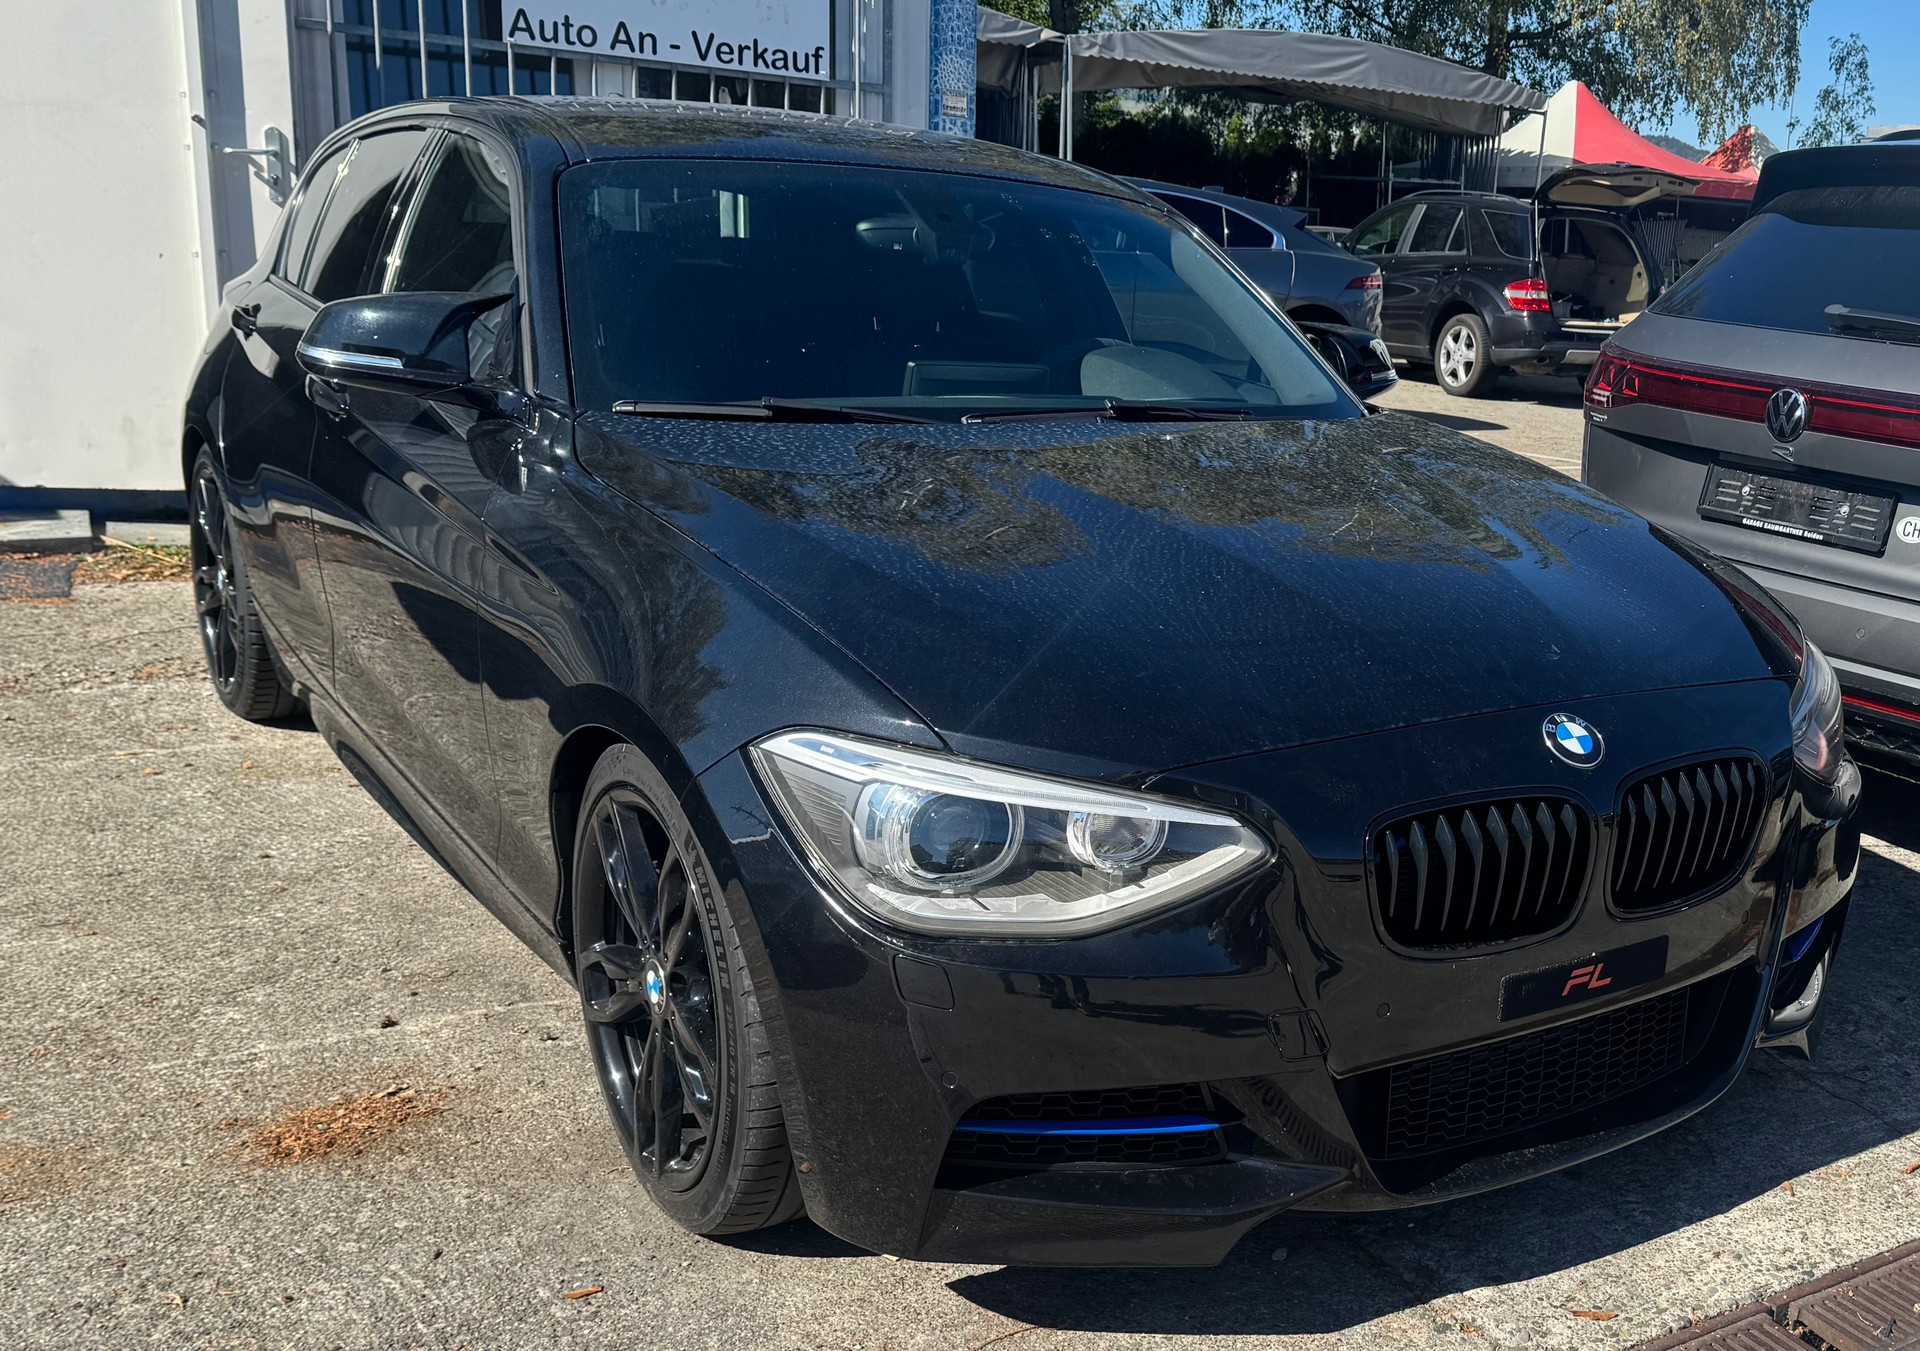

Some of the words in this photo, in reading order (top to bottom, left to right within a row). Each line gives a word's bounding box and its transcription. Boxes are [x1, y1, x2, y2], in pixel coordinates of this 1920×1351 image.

[508, 7, 598, 48] Auto
[609, 20, 658, 56] An
[691, 30, 825, 75] Verkauf
[1742, 517, 1763, 528] GARAGE
[1763, 522, 1803, 537] BAUMGARTNER
[1903, 521, 1920, 538] CH
[694, 865, 731, 990] MICHELIN
[1561, 962, 1613, 997] FL
